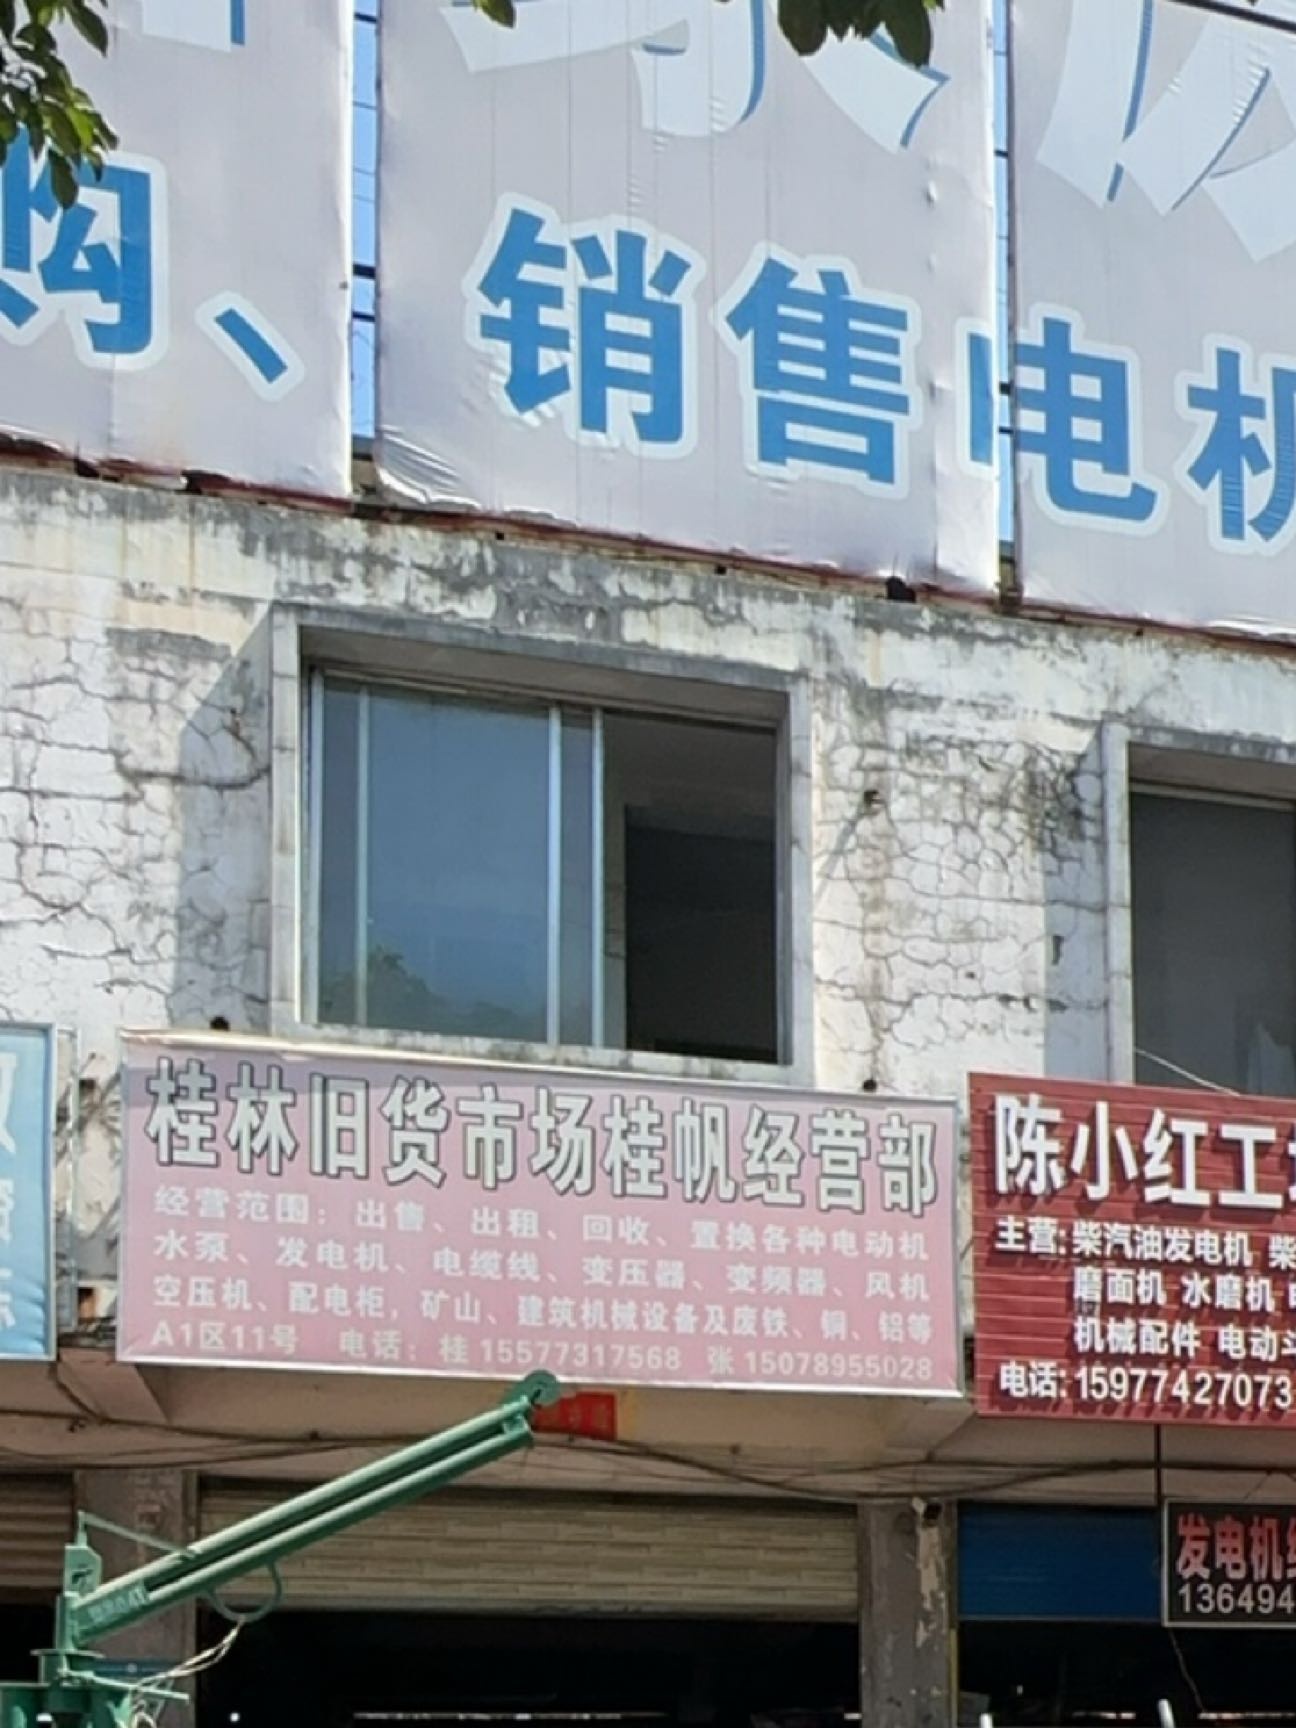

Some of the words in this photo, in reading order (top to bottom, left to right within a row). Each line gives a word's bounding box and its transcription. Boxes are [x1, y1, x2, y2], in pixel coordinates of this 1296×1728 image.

[145, 1056, 938, 1217] 桂林旧货市场桂帆经营部
[142, 1320, 300, 1354] A1区11号
[480, 1338, 682, 1371] 15577317568
[744, 1352, 934, 1381] 15078955028
[1073, 1315, 1200, 1358] 机械配件
